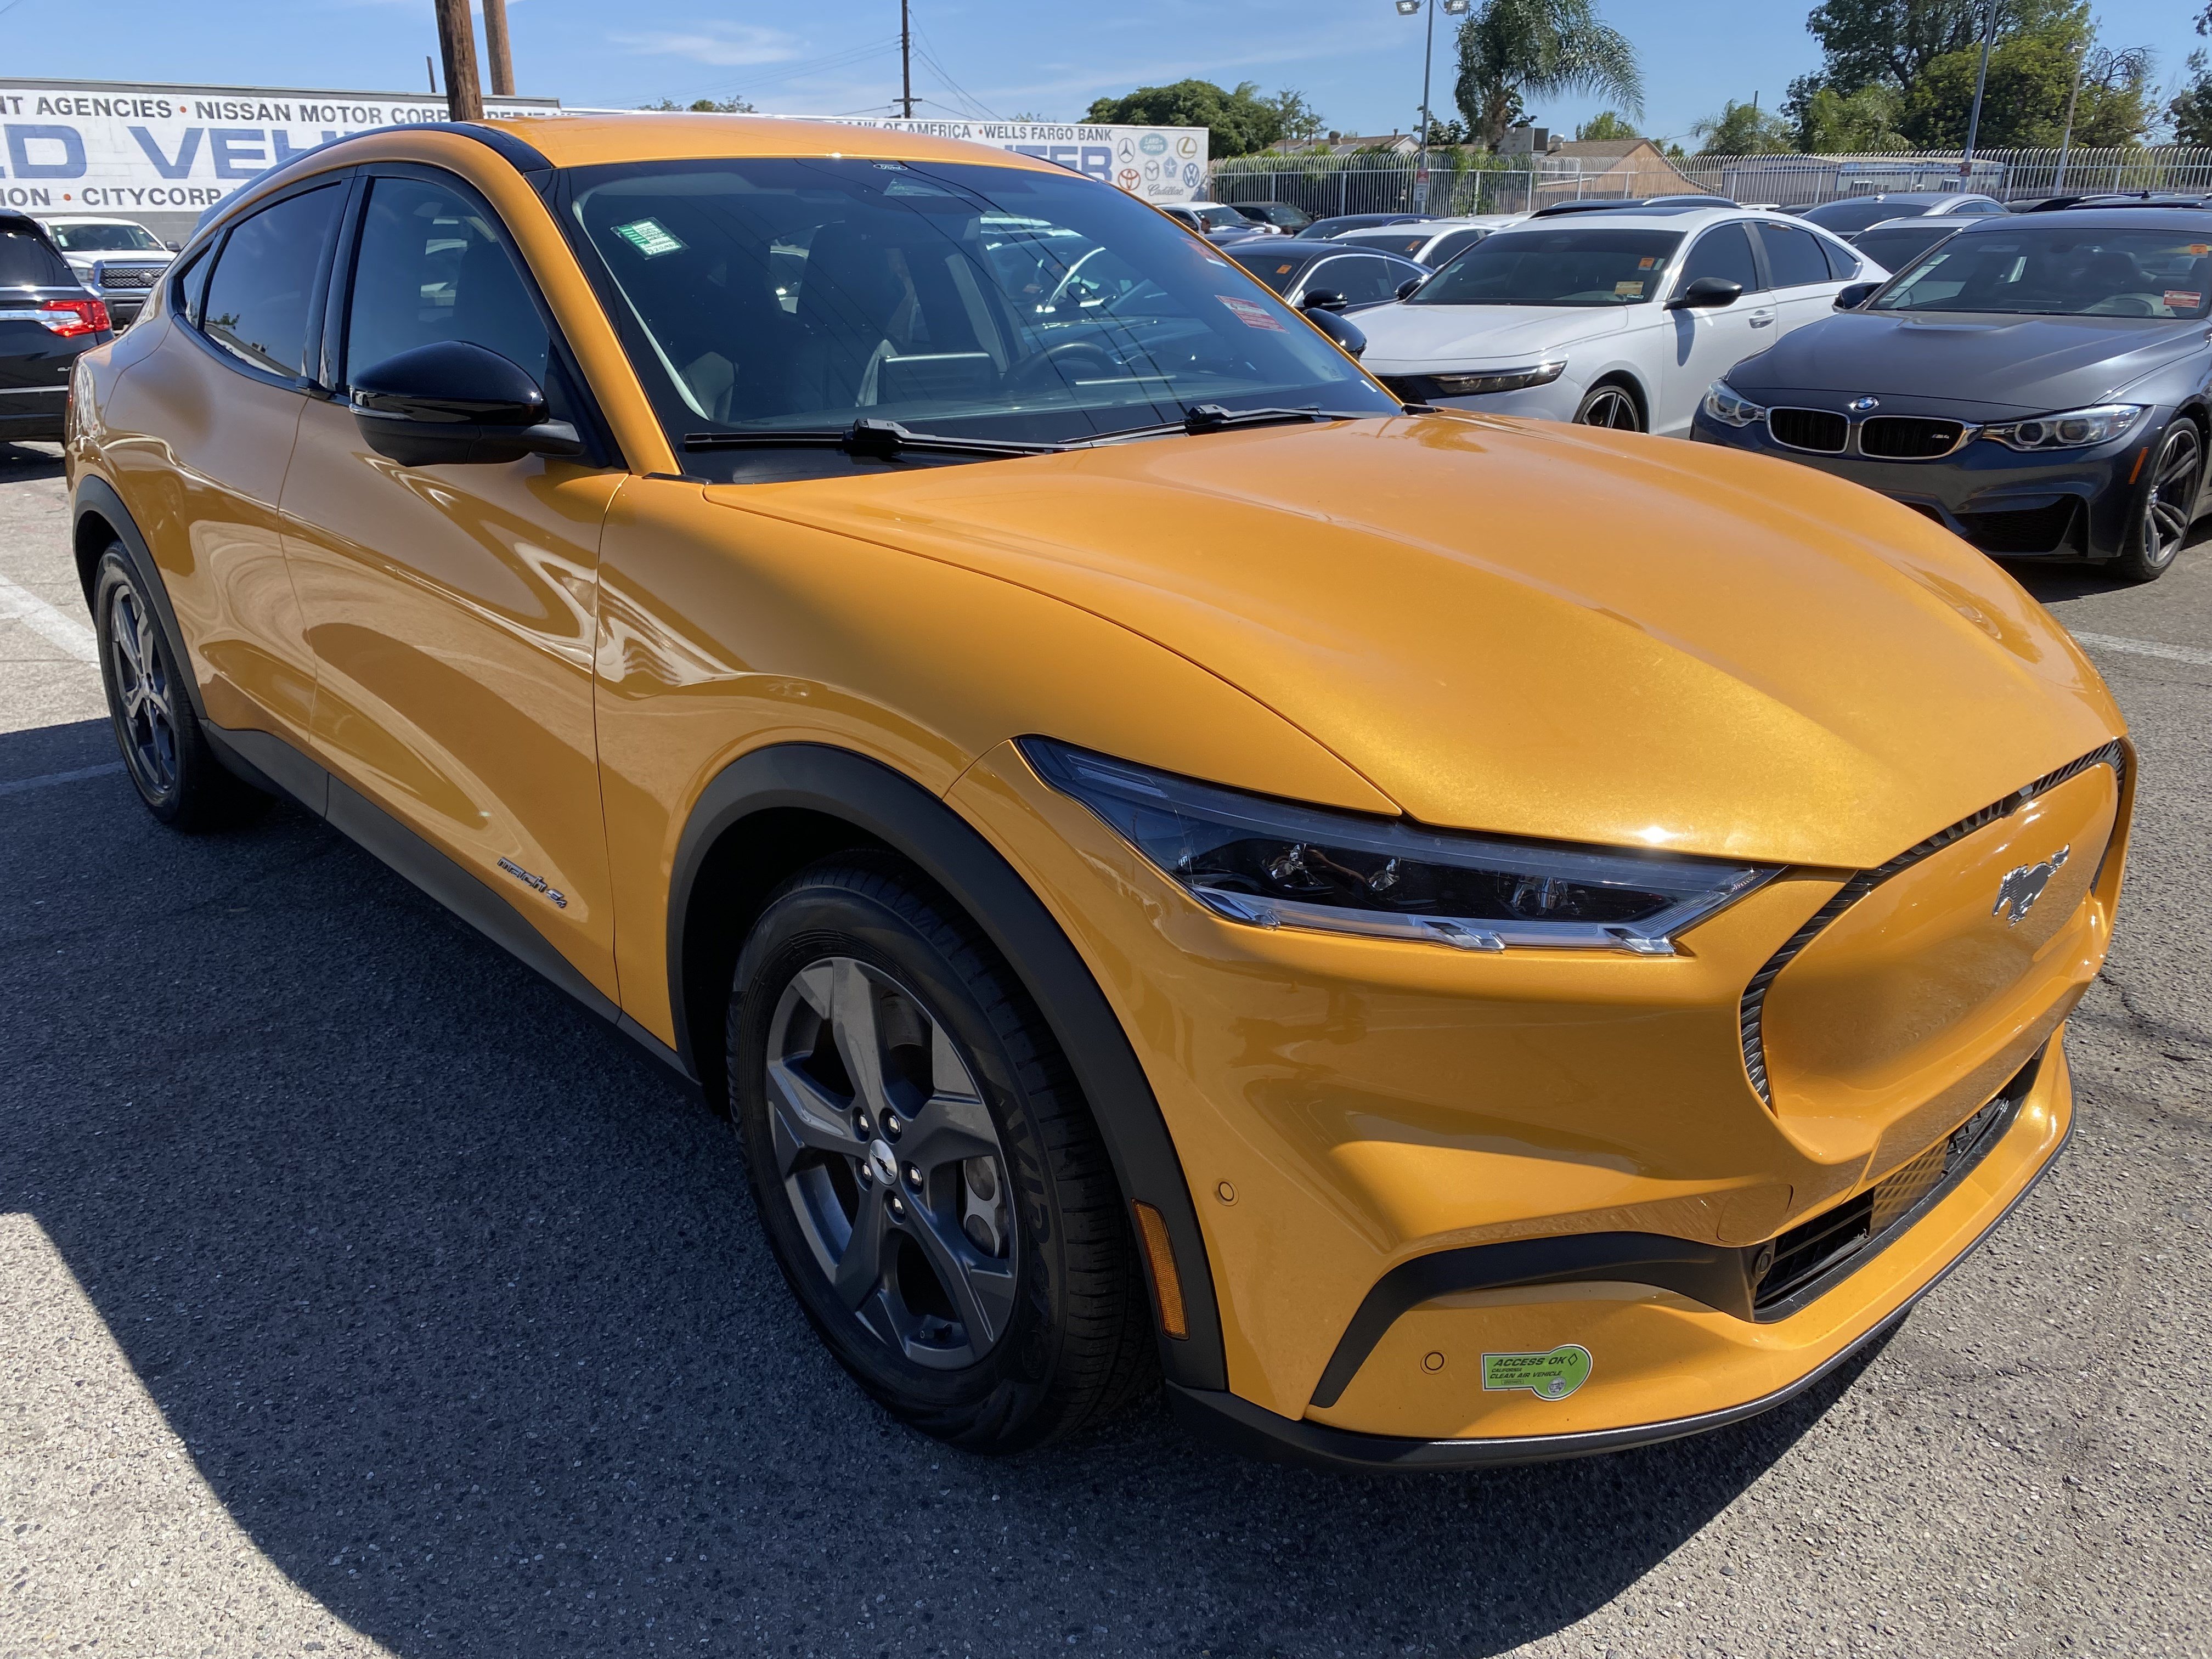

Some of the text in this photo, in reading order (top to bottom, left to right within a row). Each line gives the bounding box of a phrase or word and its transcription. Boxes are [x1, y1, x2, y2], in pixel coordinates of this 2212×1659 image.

[36, 97, 172, 119] AGENCIES
[195, 101, 291, 121] NISSAN
[300, 105, 383, 124] MOTOR
[907, 123, 972, 138] AMERICA
[984, 125, 1113, 141] WELLS FARGO BANK
[82, 188, 221, 206] CITYCORP
[1148, 184, 1184, 196] Cadillac
[1493, 1356, 1567, 1367] ACCESS OK
